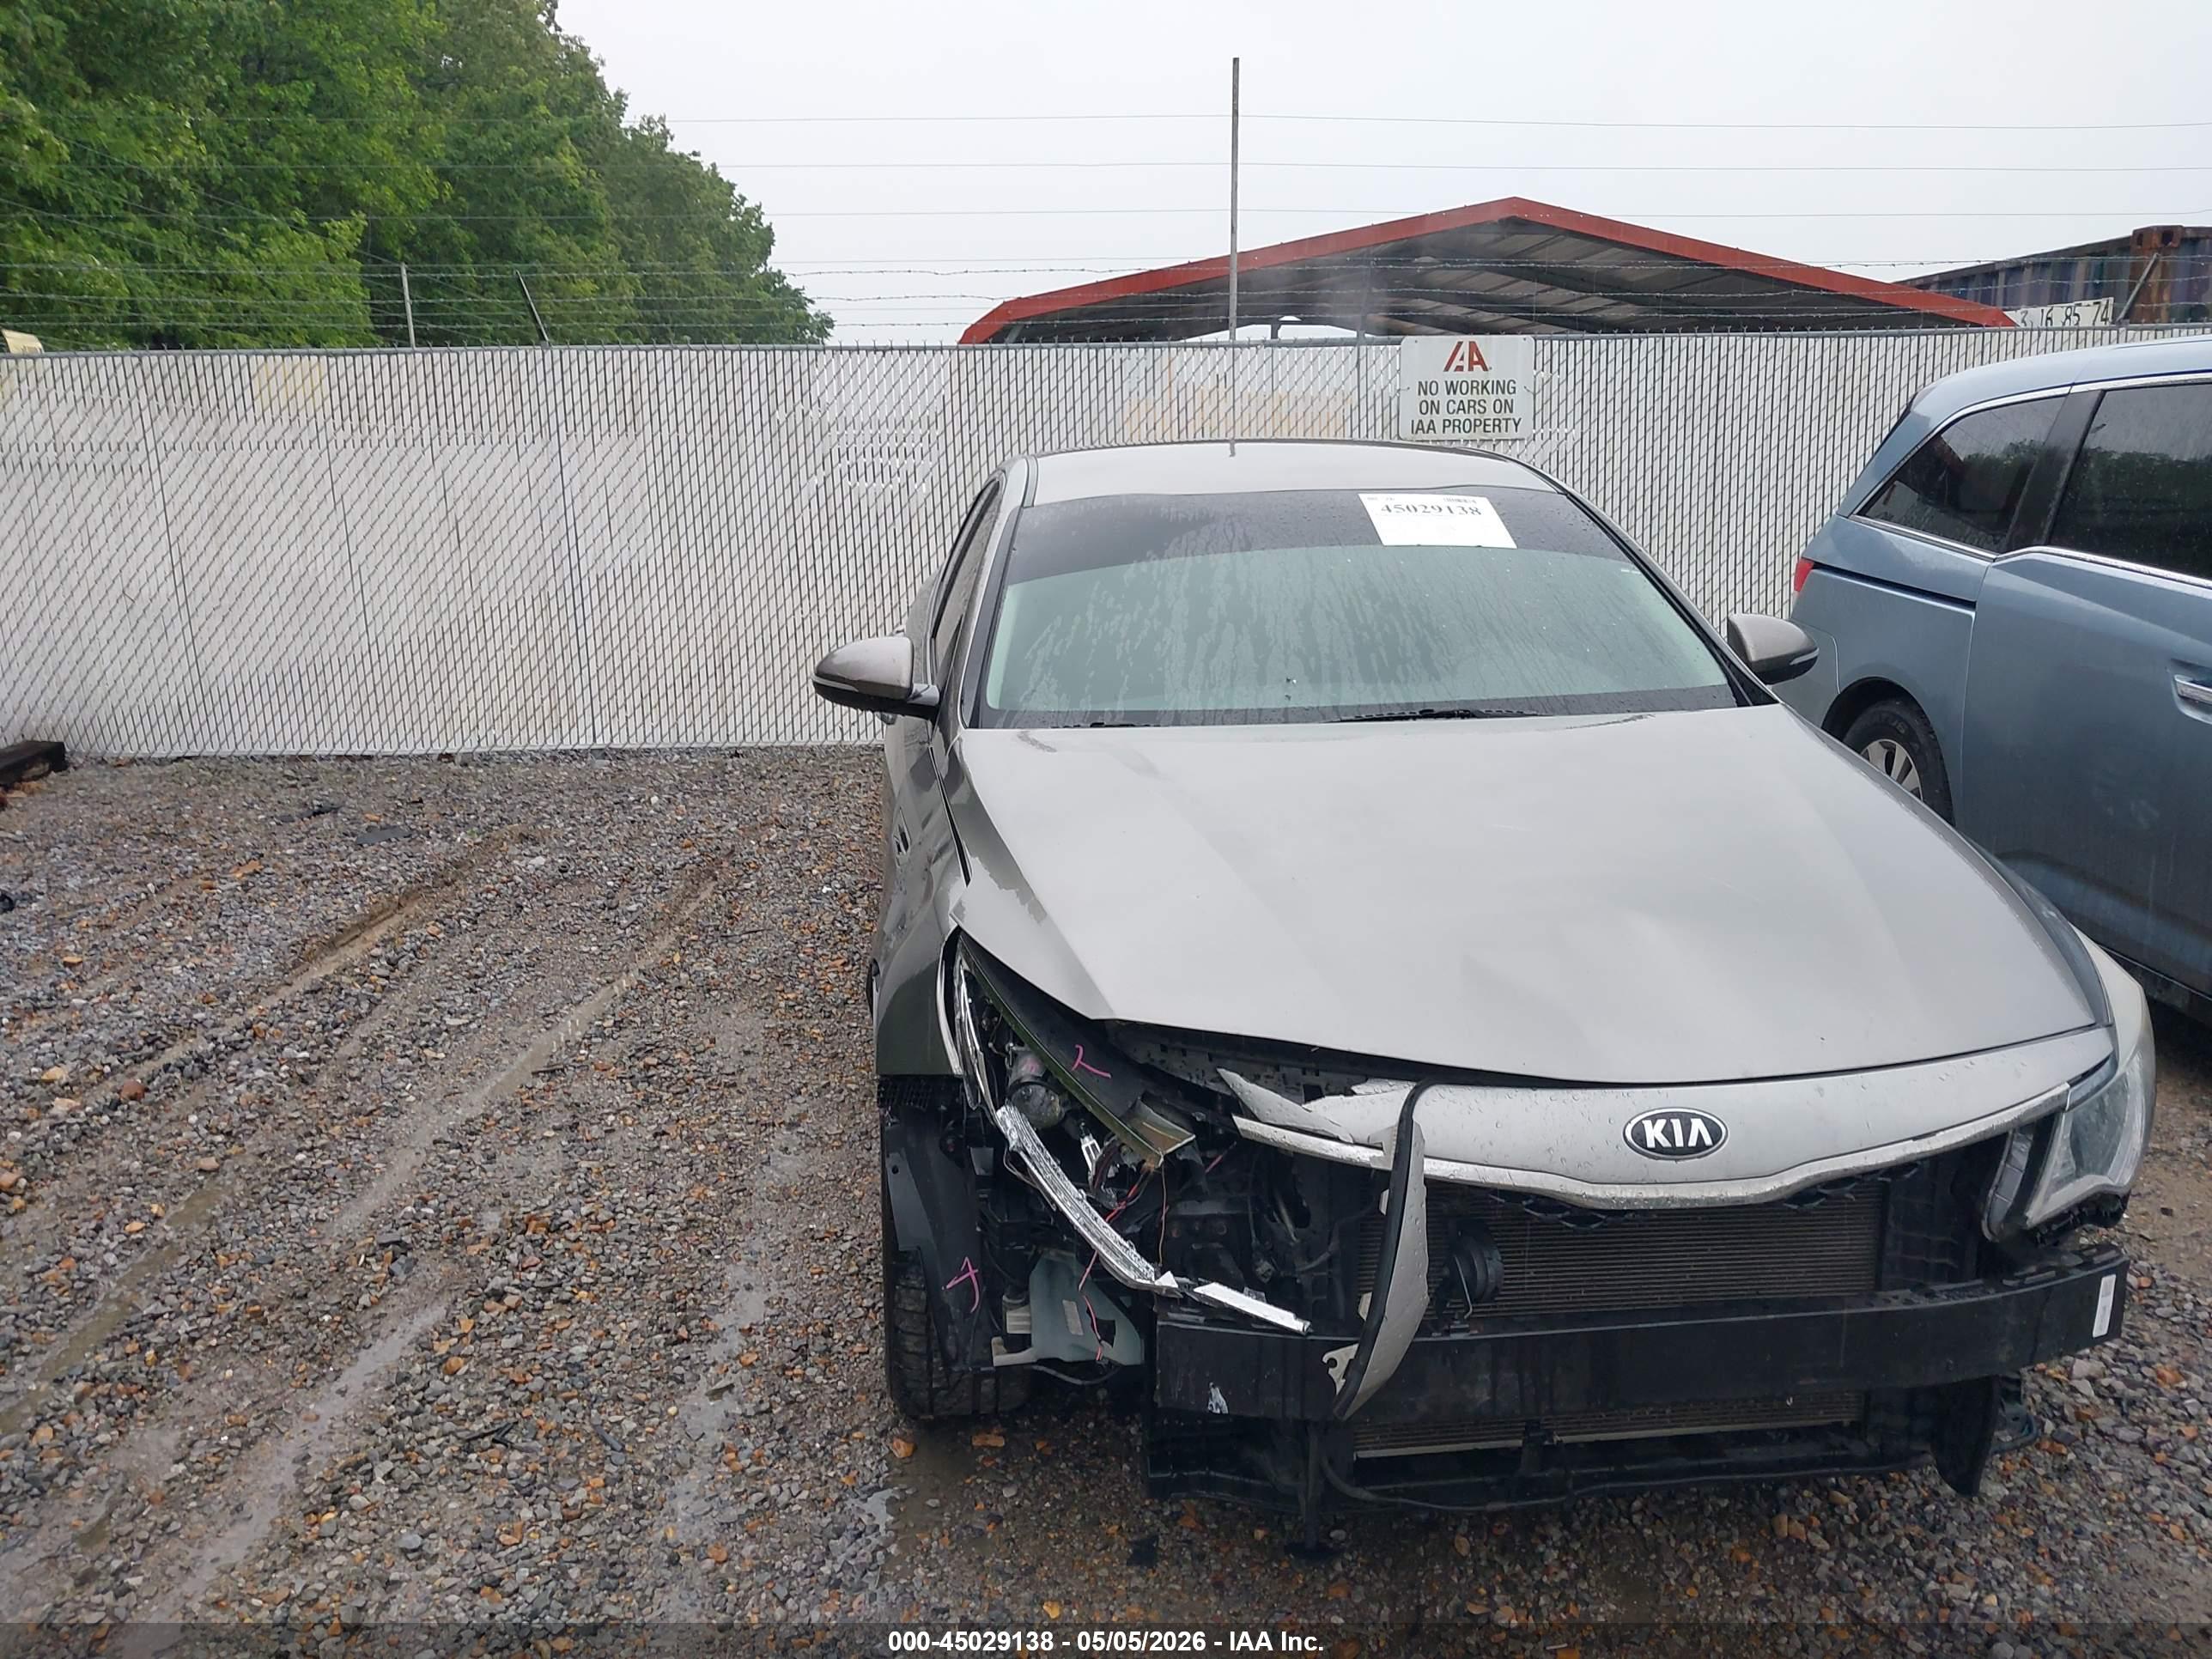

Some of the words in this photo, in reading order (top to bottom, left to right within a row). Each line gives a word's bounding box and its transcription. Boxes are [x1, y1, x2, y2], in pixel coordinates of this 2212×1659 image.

[1418, 380, 1439, 396] NO
[1445, 380, 1516, 396] WORKING
[1419, 399, 1440, 415] ON
[1446, 399, 1486, 415] CARS
[1492, 398, 1514, 414] ON
[1411, 419, 1437, 434] IAA
[1442, 418, 1522, 434] PROPERTY
[1381, 504, 1482, 515] 45029138
[1642, 1118, 1713, 1149] KIA
